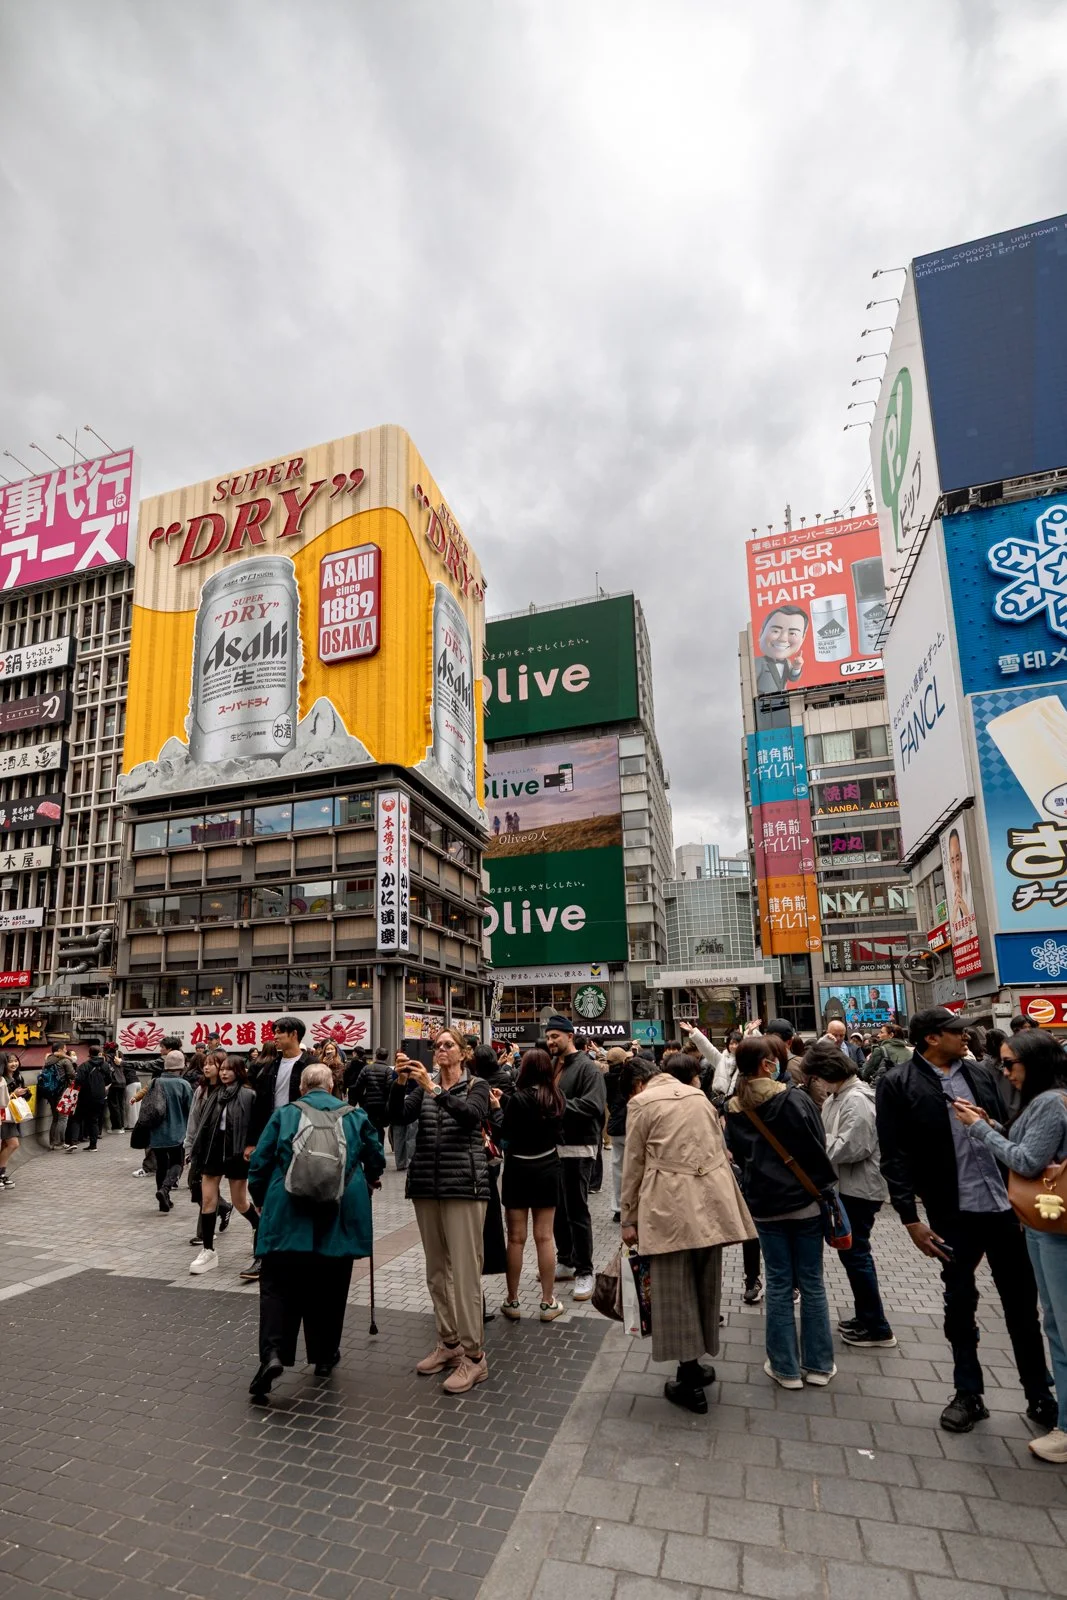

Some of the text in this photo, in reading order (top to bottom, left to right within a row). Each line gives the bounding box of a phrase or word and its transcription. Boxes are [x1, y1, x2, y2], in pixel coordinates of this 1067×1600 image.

[1010, 226, 1058, 244] Unknown
[915, 241, 1031, 278] Unknown Hard Error
[0, 451, 131, 537] 事代行は
[212, 457, 304, 504] SUPER
[438, 502, 469, 558] SUPER
[322, 553, 374, 589] ASAHI
[755, 541, 832, 571] SUPER
[756, 558, 844, 589] MILLION
[232, 593, 264, 607] SUPER
[335, 584, 361, 596] since
[757, 583, 816, 607] HAIR
[321, 590, 374, 625] 1889
[26, 643, 64, 660] しゃぶしゃぶ
[202, 620, 288, 676] Asahi
[322, 621, 374, 656] OSAKA
[233, 669, 255, 688] 生
[437, 648, 471, 712] Asahi
[845, 661, 878, 673] ルアン
[41, 695, 61, 719] 刀
[218, 697, 270, 715] スーパードライ
[900, 676, 945, 772] FANCL
[0, 753, 31, 772] 酒屋
[869, 801, 882, 809] All
[382, 816, 394, 866] 本場の味
[499, 830, 548, 844] Oliveの人
[381, 872, 395, 944] かに道楽
[573, 1025, 626, 1035] TSUTAYA
